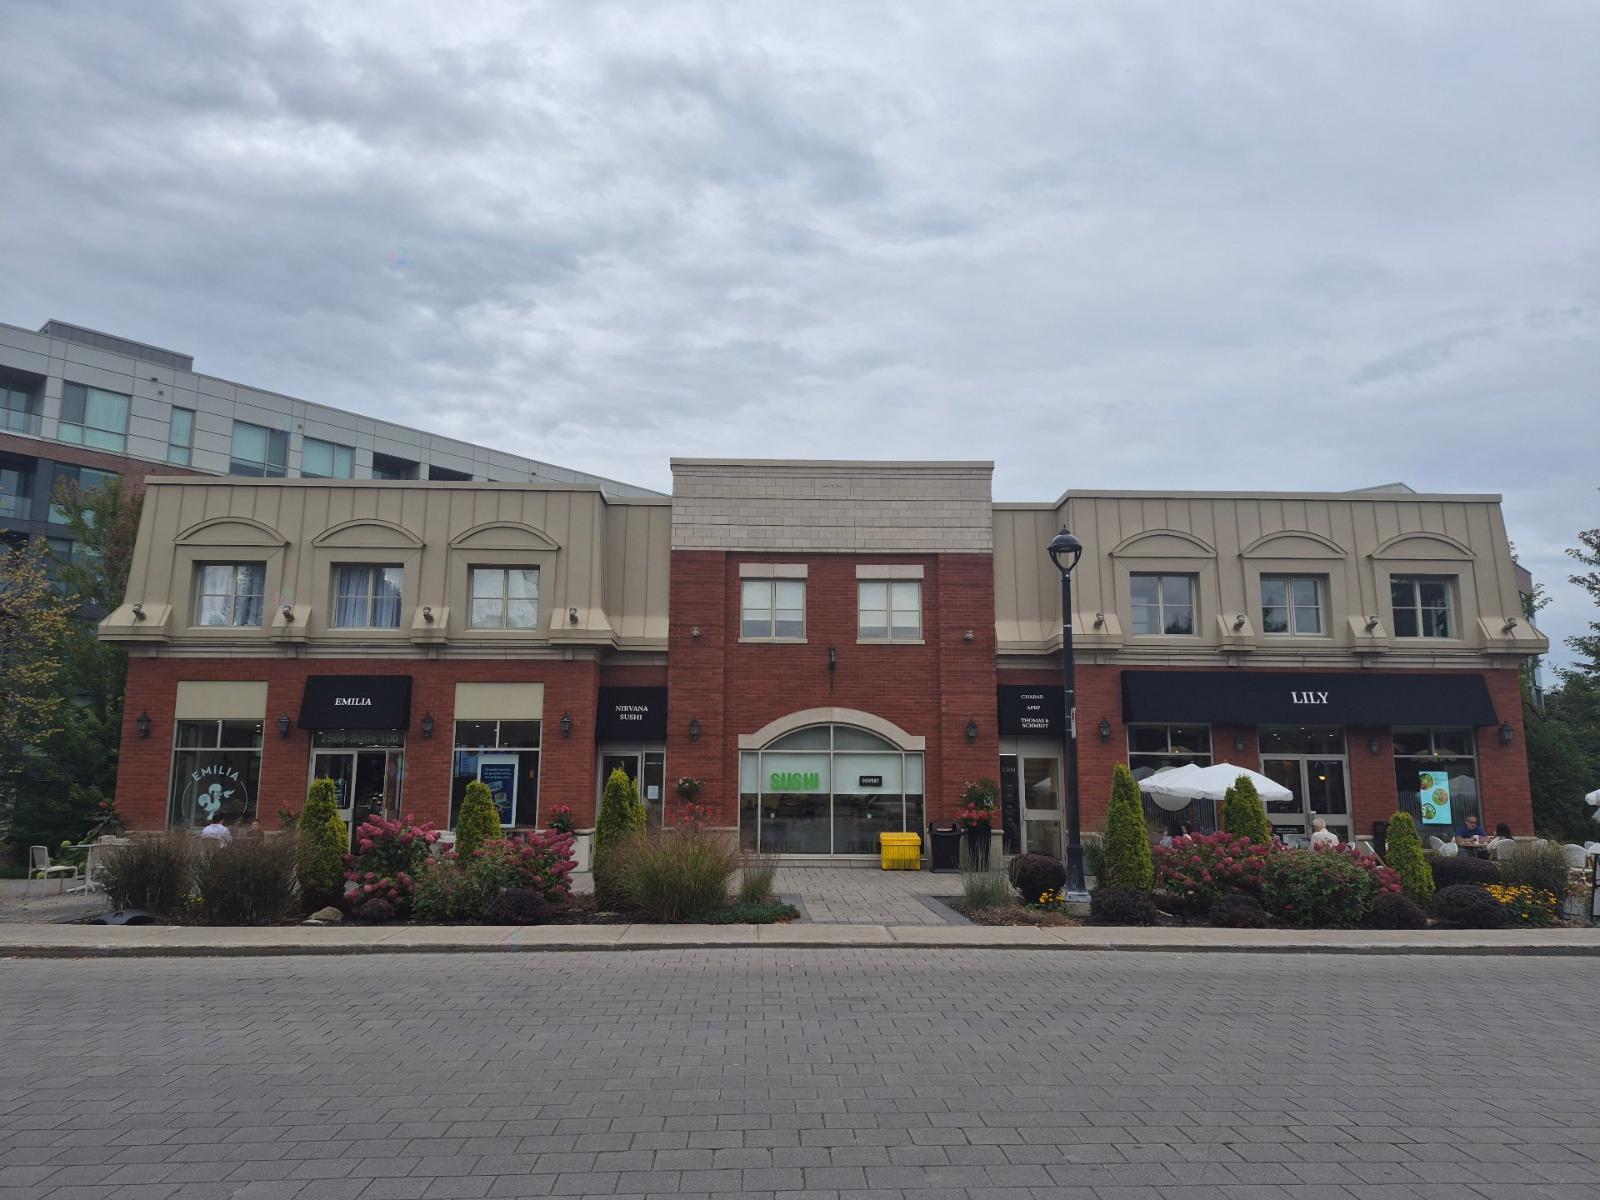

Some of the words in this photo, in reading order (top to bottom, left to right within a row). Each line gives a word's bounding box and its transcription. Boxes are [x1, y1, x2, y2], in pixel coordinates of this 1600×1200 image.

[334, 697, 372, 706] EMILIA
[1290, 691, 1329, 704] LILY
[619, 713, 643, 721] SUSHI
[382, 734, 399, 743] 100
[191, 765, 240, 781] EMILIA
[770, 772, 820, 791] SUSHI
